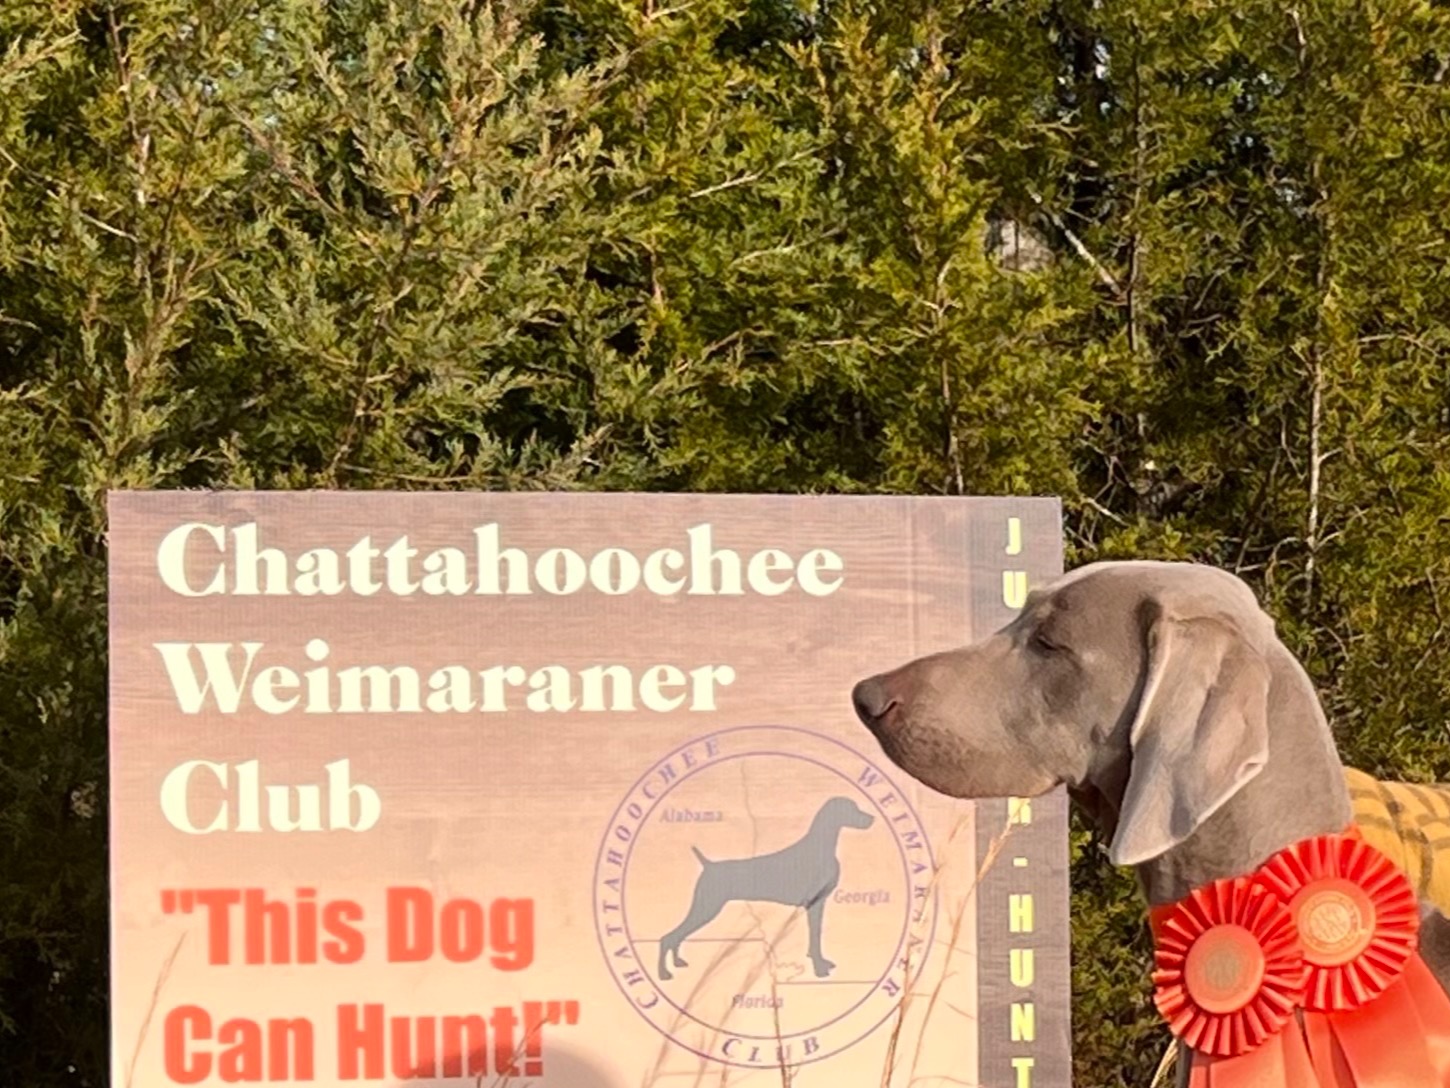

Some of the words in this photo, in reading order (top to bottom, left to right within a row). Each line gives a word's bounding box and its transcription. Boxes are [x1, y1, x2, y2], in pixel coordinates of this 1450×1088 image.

[156, 521, 845, 597] Chattahoochee
[152, 638, 736, 716] Weimaraner
[158, 758, 383, 836] Club
[659, 808, 724, 823] Alabama
[602, 738, 720, 1011] CHATTAHOOCHEE
[833, 888, 890, 907] Georgia
[159, 887, 366, 967] "This
[385, 886, 536, 972] Dog
[732, 993, 784, 1009] Florida
[162, 1004, 315, 1086] Can
[336, 999, 581, 1081] Hunt!"
[721, 1036, 820, 1064] CLUB
